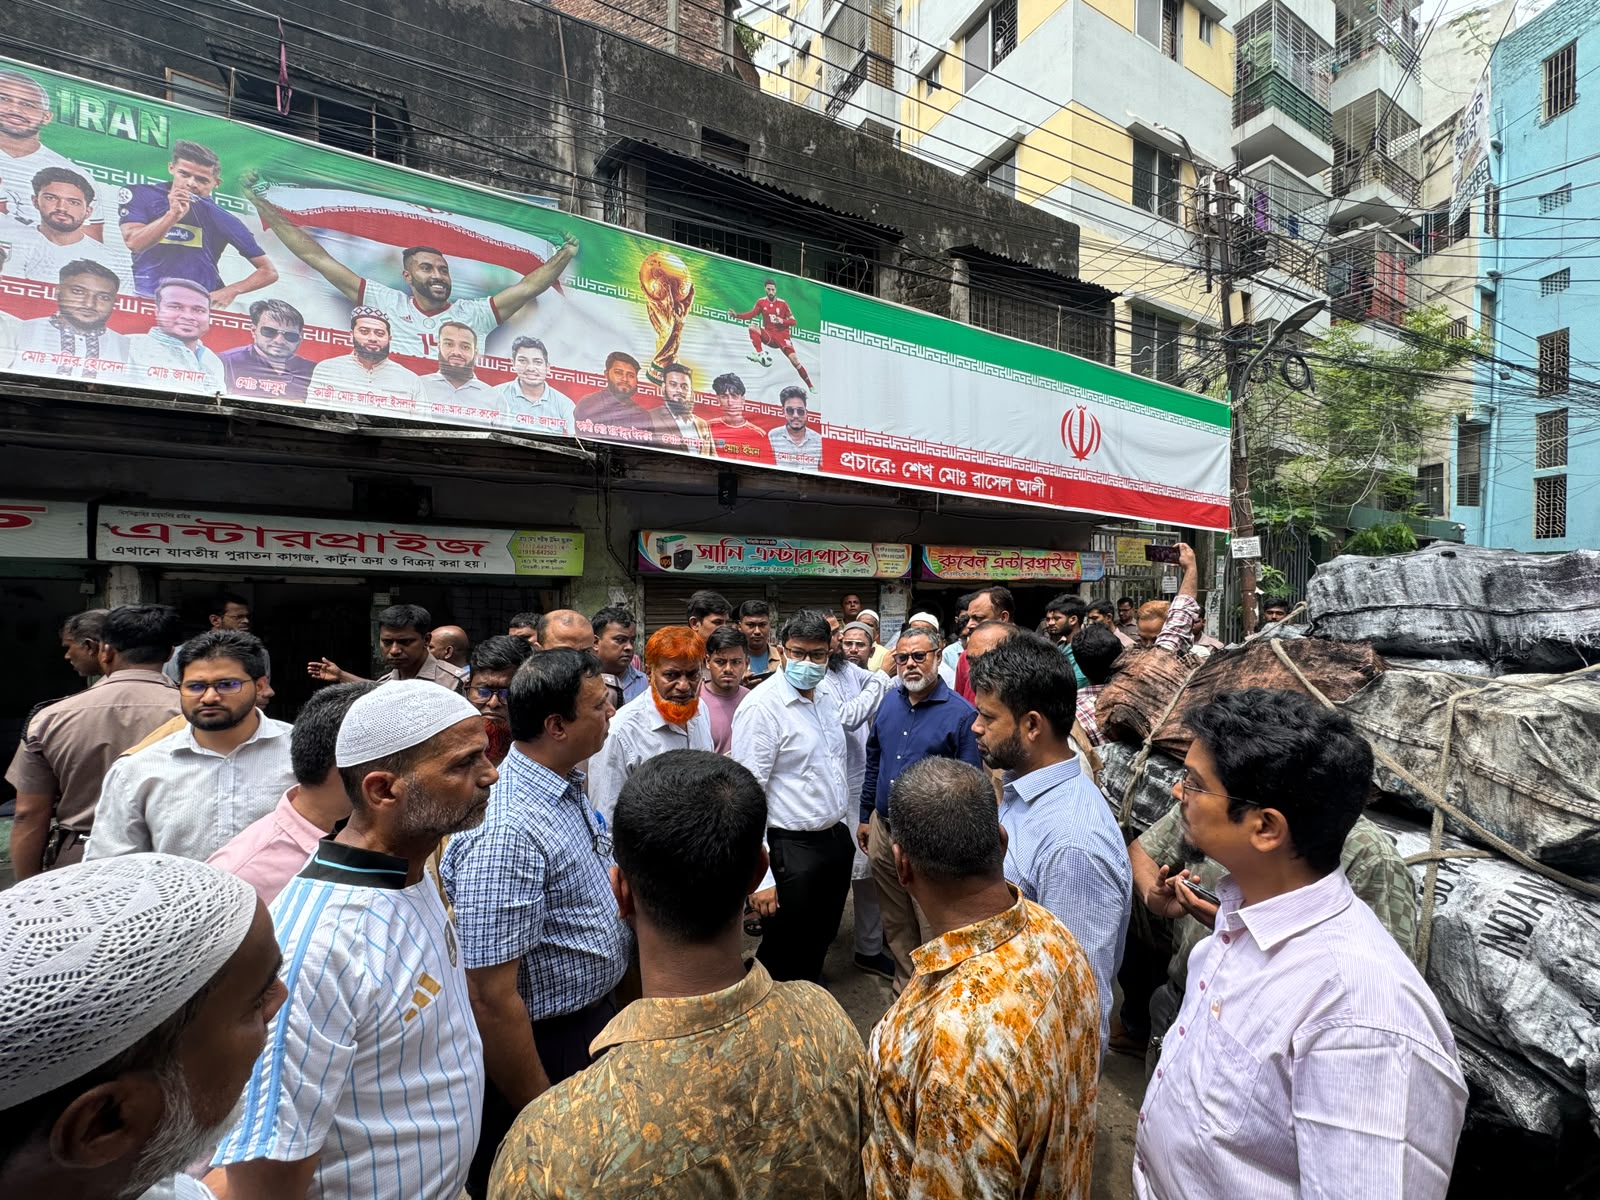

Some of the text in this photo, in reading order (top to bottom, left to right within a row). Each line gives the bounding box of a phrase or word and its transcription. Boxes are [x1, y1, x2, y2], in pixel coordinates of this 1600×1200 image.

[57, 88, 169, 149] IRAN
[22, 350, 46, 363] মোঃ
[84, 356, 125, 373] হোসেন
[147, 366, 206, 384] মোঃ জামান
[235, 376, 257, 391] মোঃ
[515, 413, 567, 430] মোঃ জামান
[902, 460, 934, 480] শেখ
[938, 466, 967, 486] মোঃ
[971, 470, 1013, 493] রাসেল
[110, 518, 492, 557] এন্টারপ্রাইজ
[112, 546, 160, 557] এখানে
[166, 546, 218, 560] যাবতীয়
[225, 549, 271, 563] পুরাতন
[276, 552, 320, 564] কাগজ,
[361, 556, 383, 566] ক্রয়
[389, 557, 398, 566] ও
[402, 555, 434, 568] বিক্রয়
[439, 559, 460, 569] করা
[694, 537, 744, 565] সানি
[750, 540, 873, 568] এন্টারপ্রাইজ
[939, 554, 987, 570] রুবেল
[991, 551, 1077, 574] এন্টারপ্রাইজ
